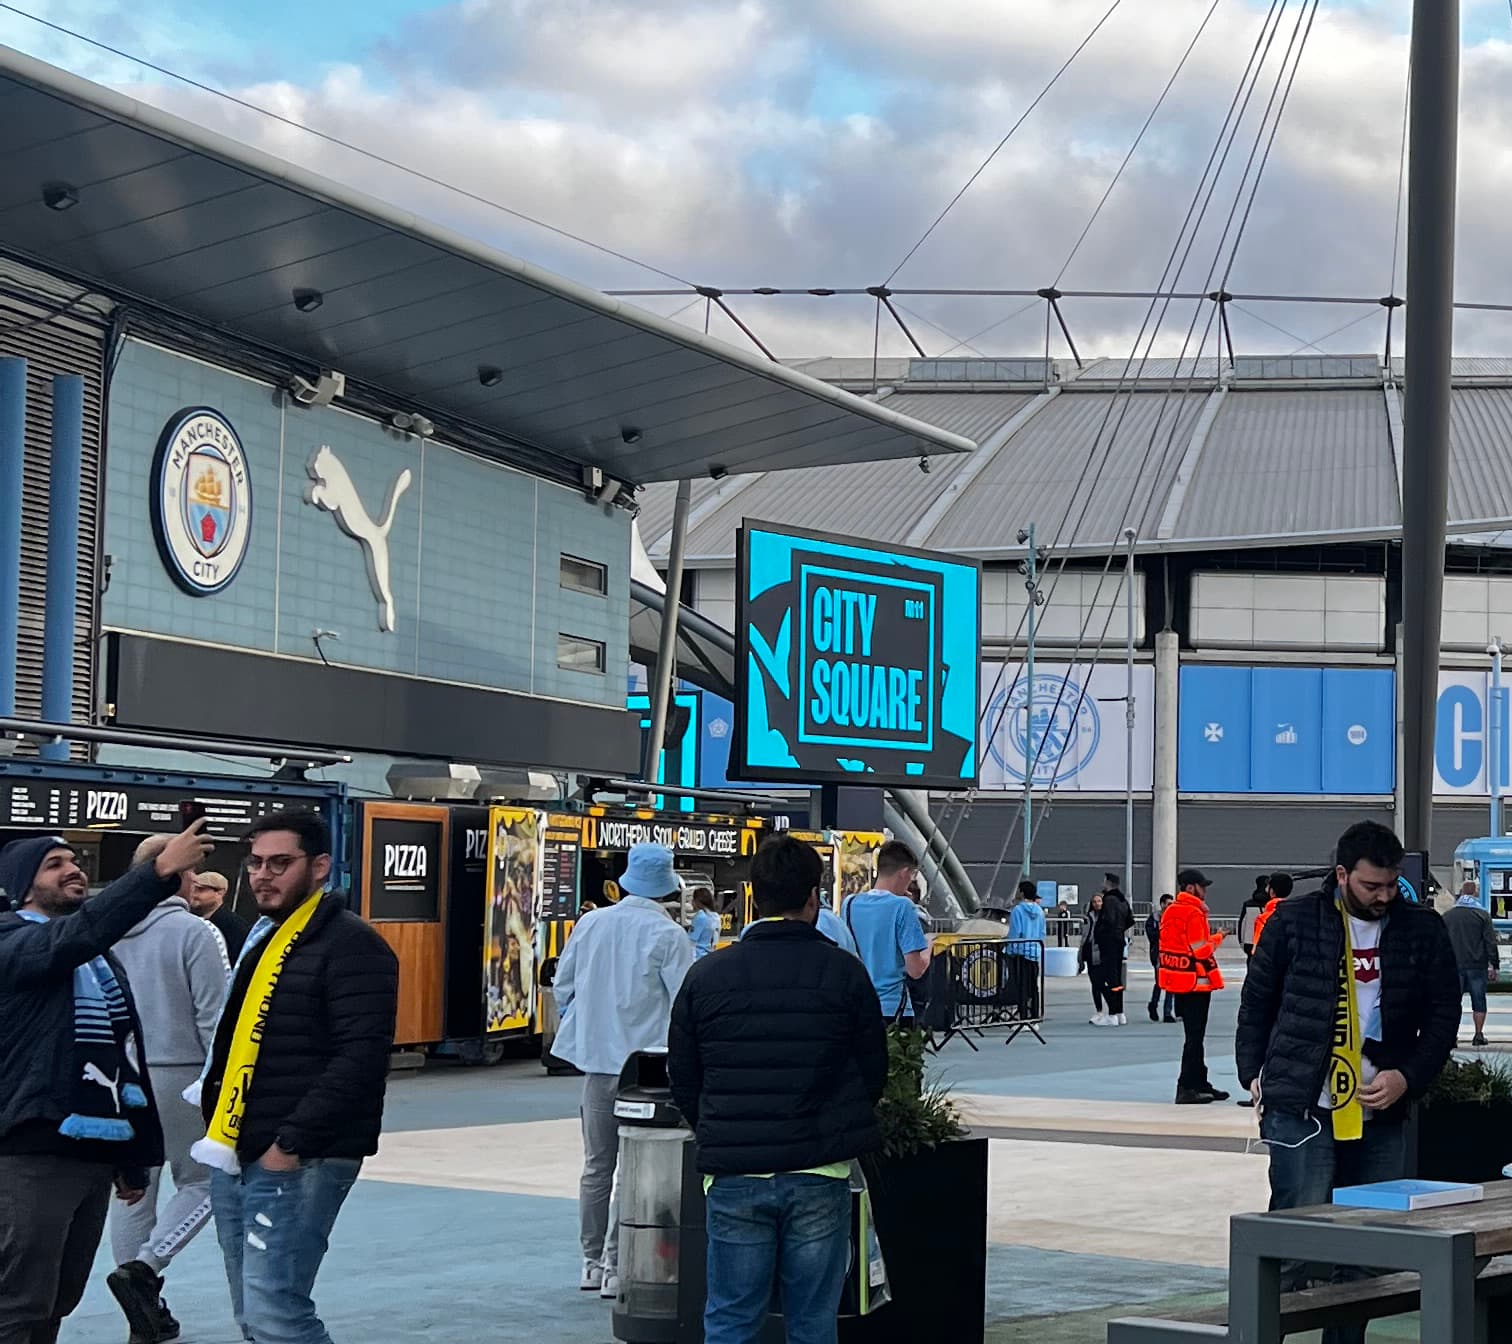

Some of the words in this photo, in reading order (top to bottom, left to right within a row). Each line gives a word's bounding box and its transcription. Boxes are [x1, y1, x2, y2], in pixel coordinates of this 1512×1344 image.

[173, 423, 245, 486] MANCHESTER
[193, 561, 220, 580] CITY
[813, 586, 877, 656] CITY
[811, 659, 922, 731] SQUARE
[86, 790, 128, 821] PIZZA
[466, 829, 487, 859] PIZ
[598, 821, 651, 847] NORTHERN
[708, 829, 737, 853] CHEESE
[384, 844, 427, 877] PIZZA
